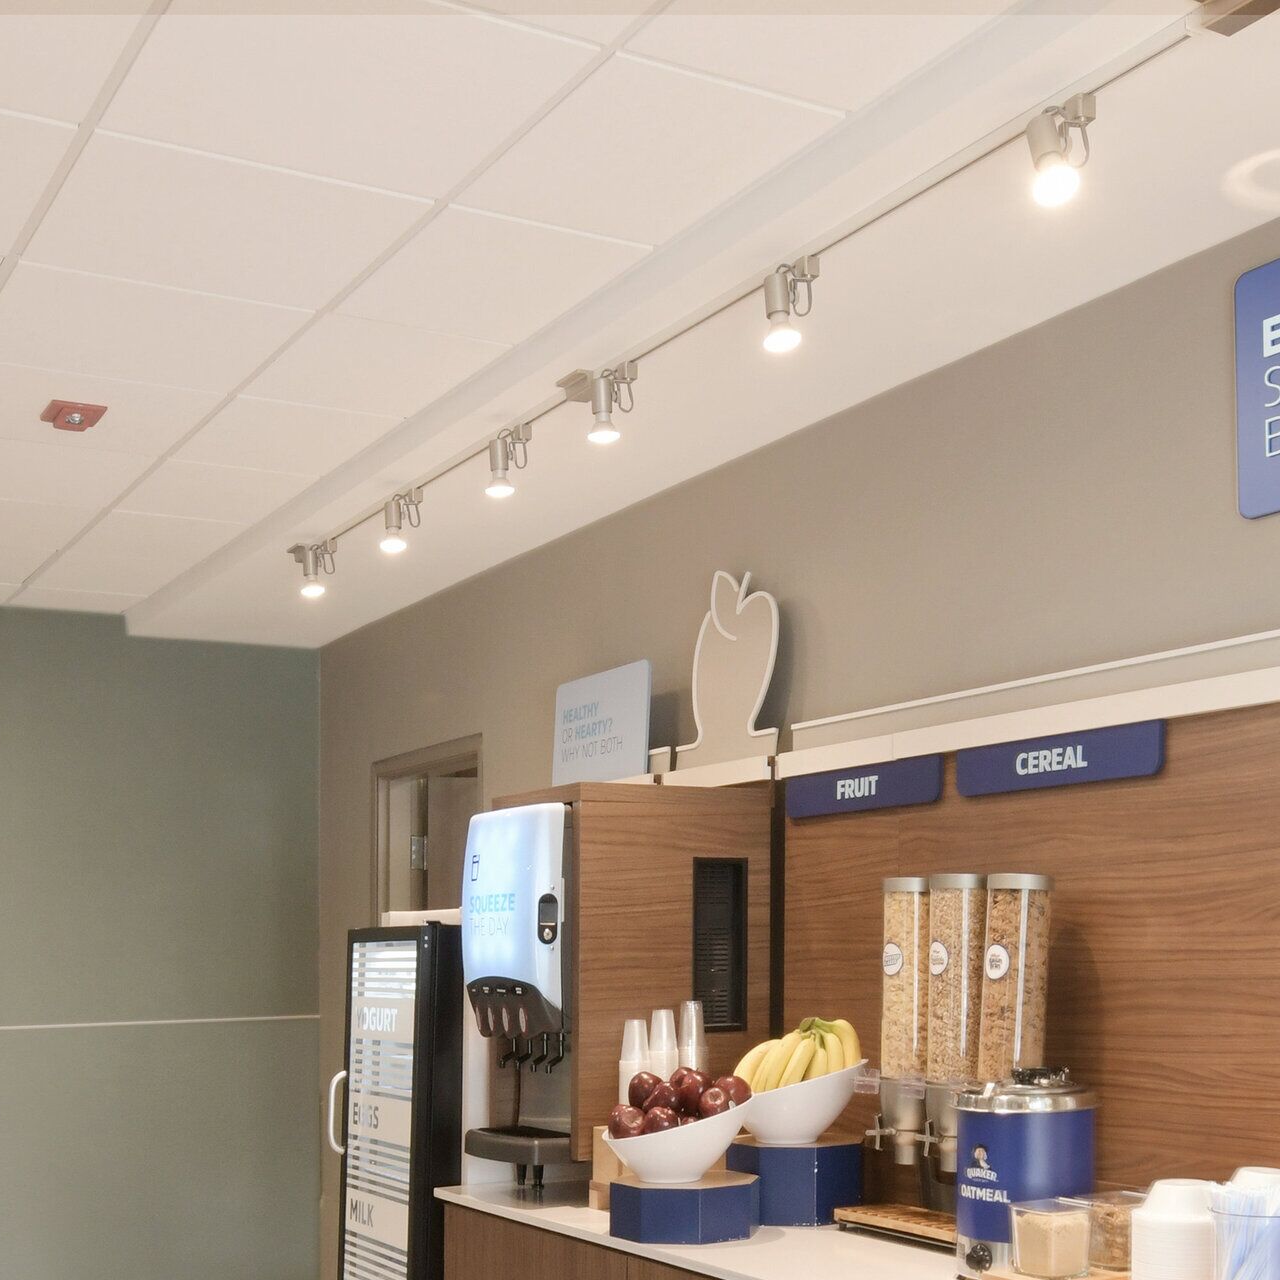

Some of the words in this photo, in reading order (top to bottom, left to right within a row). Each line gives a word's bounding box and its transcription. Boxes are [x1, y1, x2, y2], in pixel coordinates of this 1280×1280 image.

[562, 701, 599, 725] HEALTHY
[600, 735, 623, 755] BOTH
[1015, 745, 1088, 775] CEREAL
[836, 775, 879, 800] FRUIT
[469, 893, 517, 914] SQUEEZE
[470, 917, 486, 936] THE
[488, 916, 510, 937] DAY
[966, 1167, 998, 1182] QUAKER
[961, 1184, 1011, 1204] OATMEAL
[349, 1198, 374, 1228] MILK
